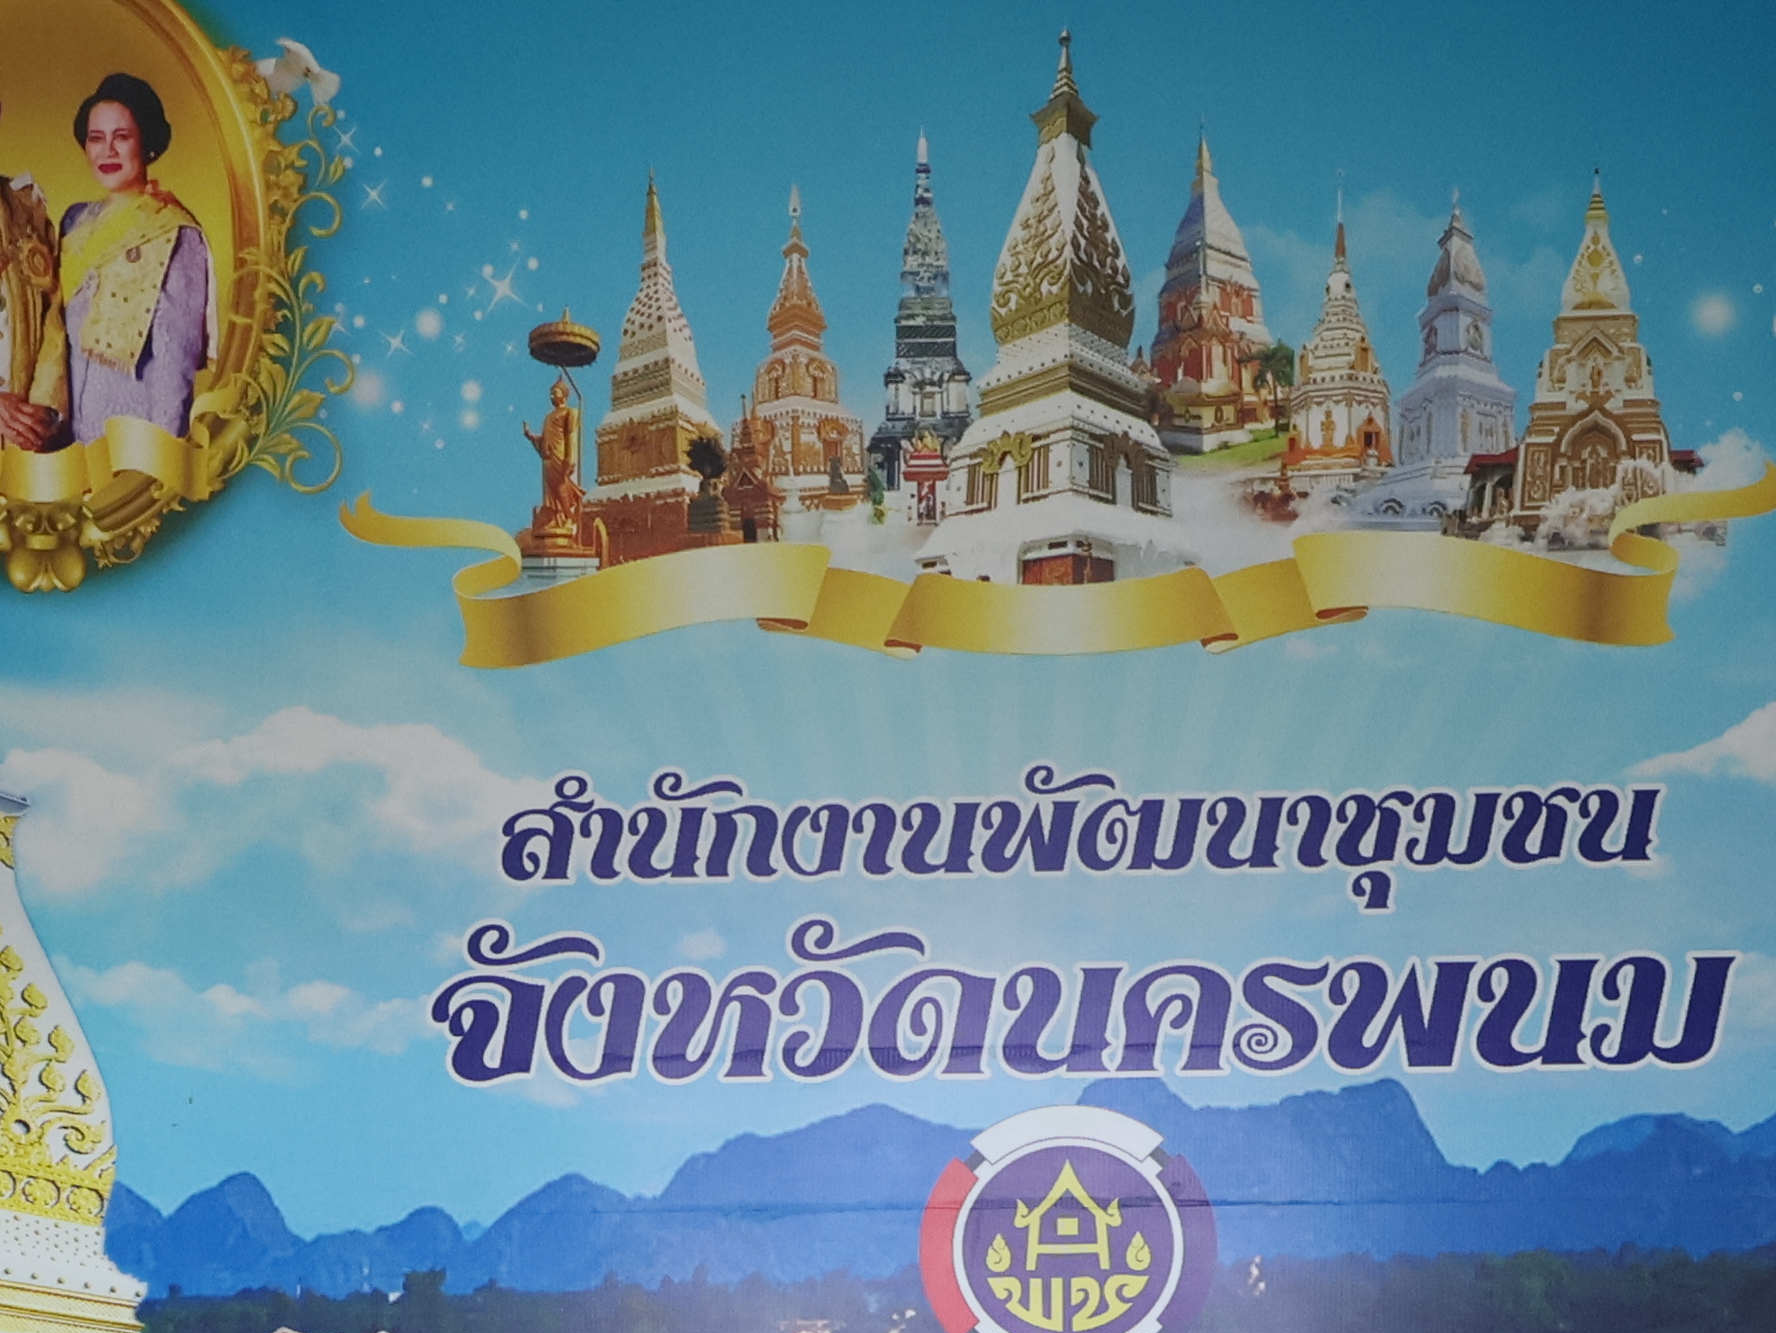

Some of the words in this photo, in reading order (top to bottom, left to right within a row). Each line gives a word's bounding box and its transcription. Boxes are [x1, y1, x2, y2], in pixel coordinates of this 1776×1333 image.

[500, 764, 1664, 911] สำนักงานพัฒนาชุมชน
[429, 918, 1743, 1087] จังหวัดนครพนม
